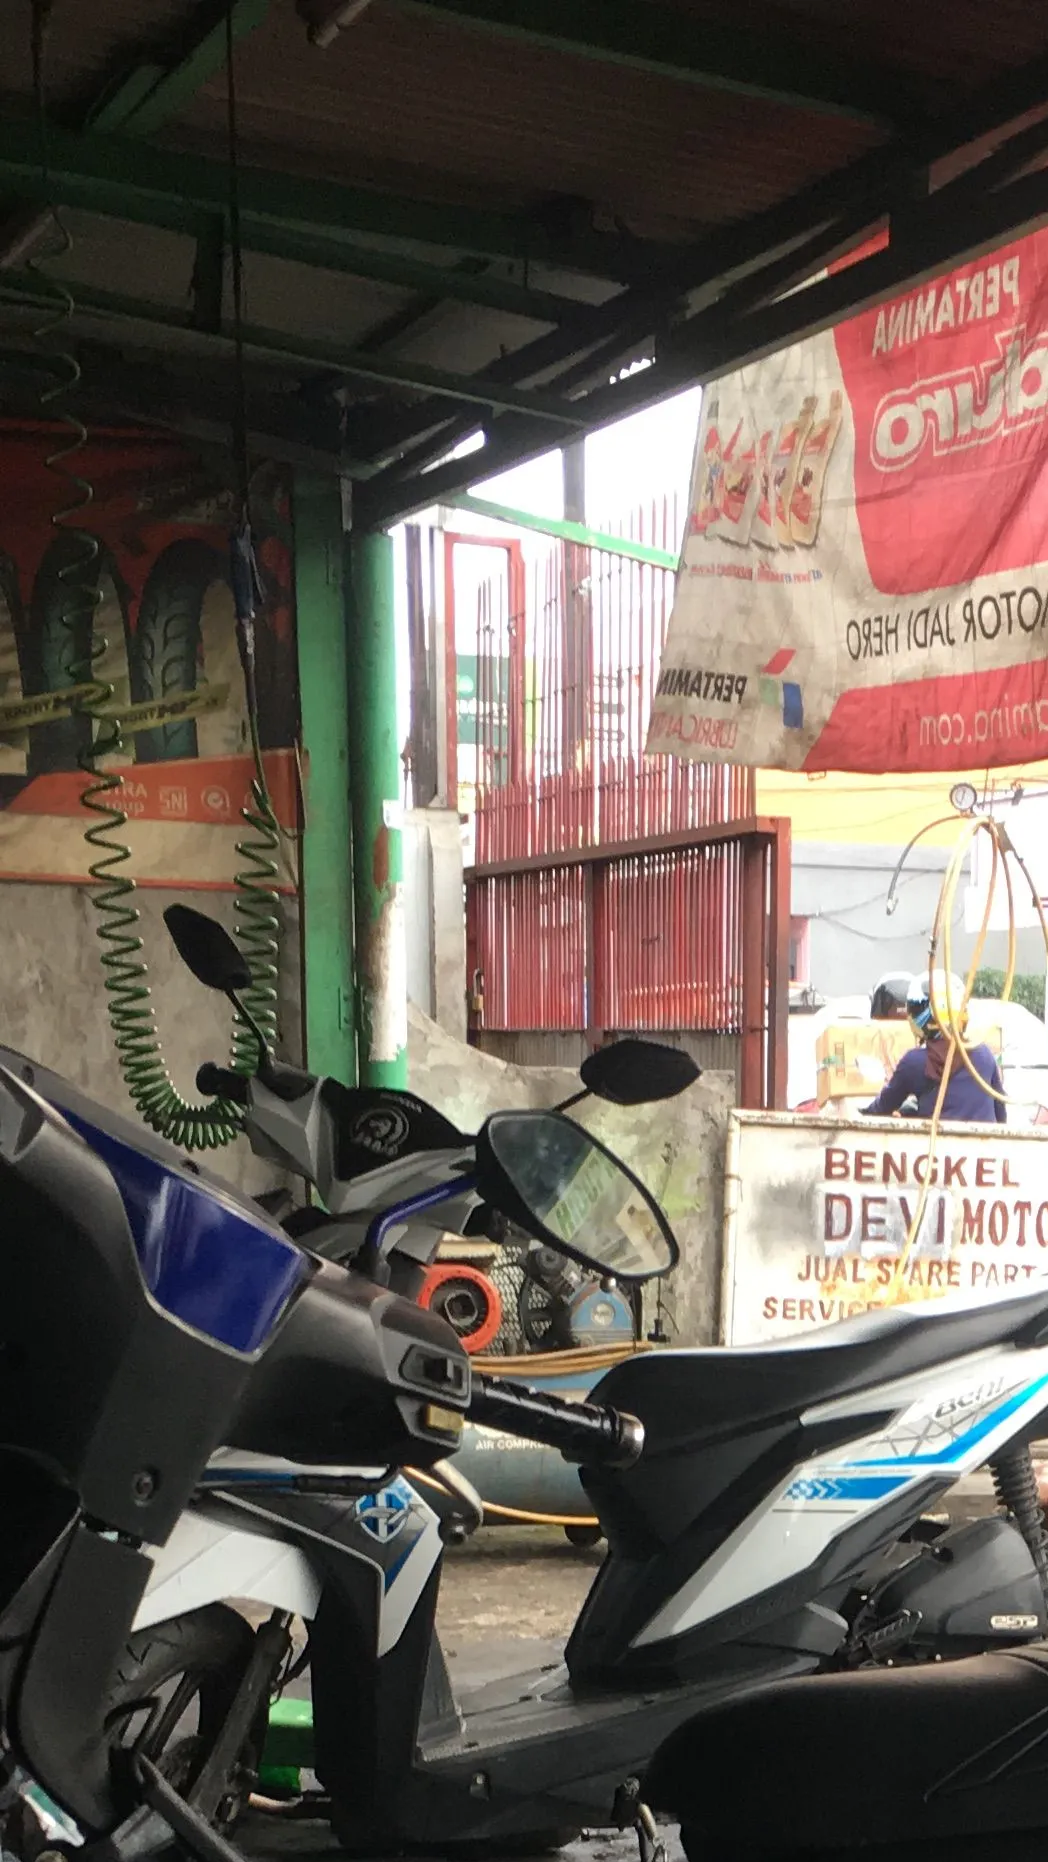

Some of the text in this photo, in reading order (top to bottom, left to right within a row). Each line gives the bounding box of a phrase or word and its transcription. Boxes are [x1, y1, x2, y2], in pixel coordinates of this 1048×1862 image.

[824, 1147, 1020, 1188] BENGKEL
[824, 1192, 946, 1245] DEVI
[797, 1254, 868, 1283] JUAL
[476, 1439, 495, 1450] AIR
